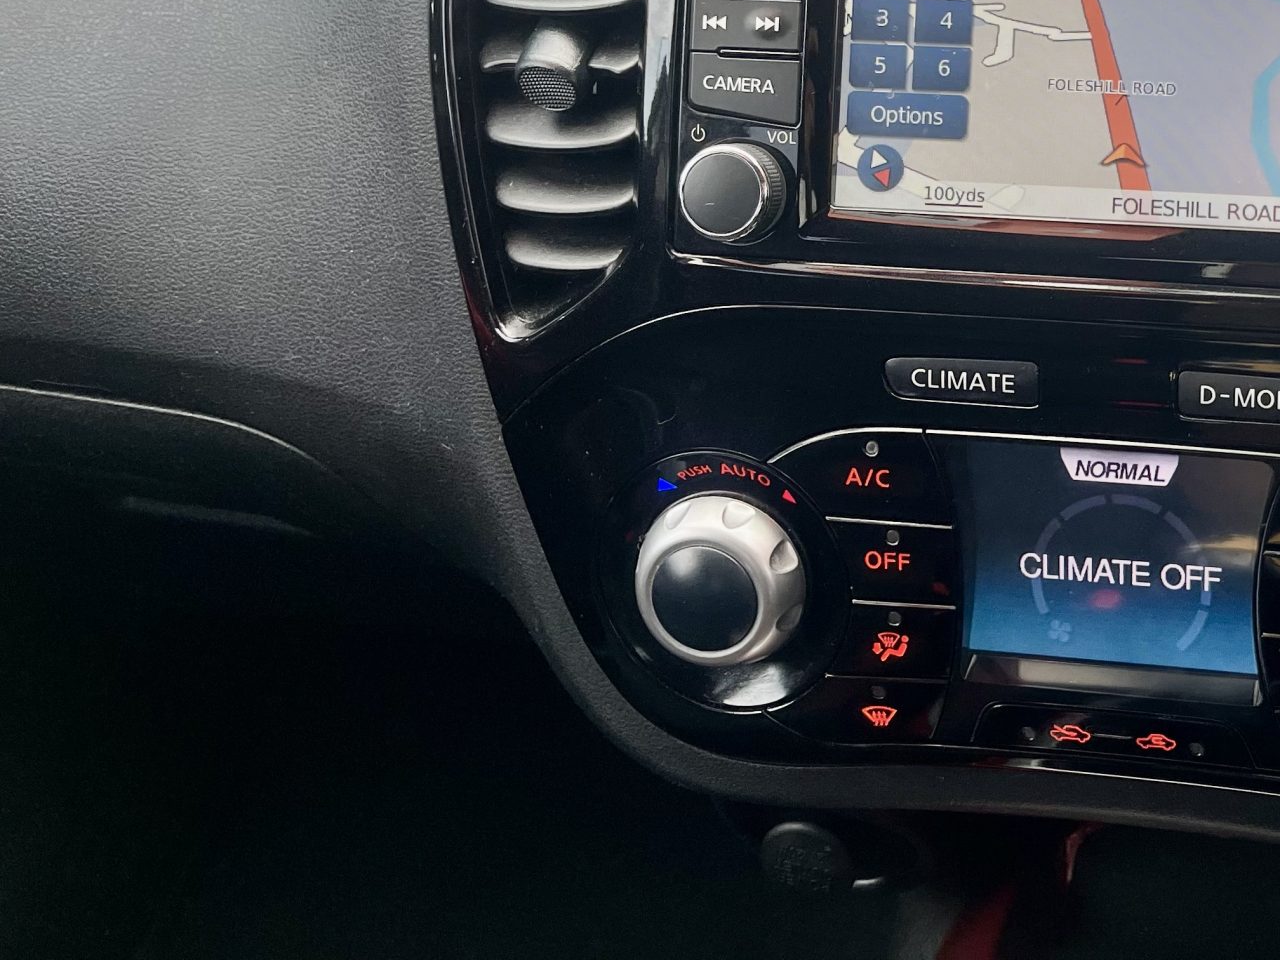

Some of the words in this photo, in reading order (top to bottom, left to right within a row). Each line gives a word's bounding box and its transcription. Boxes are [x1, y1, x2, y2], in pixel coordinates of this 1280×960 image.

[876, 10, 889, 27] 3
[940, 13, 953, 29] 4
[874, 58, 886, 75] 5
[938, 60, 951, 77] 6
[702, 75, 775, 95] CAMERA
[1047, 78, 1126, 94] FOLESHILL
[1132, 81, 1177, 96] ROAD
[870, 106, 943, 128] Options
[767, 131, 797, 145] VOL
[924, 185, 986, 204] 100yds
[1111, 197, 1219, 221] FOLESHILL
[911, 368, 1015, 394] CLIMATE
[677, 464, 713, 481] PUSH
[719, 463, 771, 487] AUTO
[845, 469, 890, 489] A/C
[1075, 459, 1165, 483] NORMAL
[864, 550, 911, 571] OFF
[1019, 553, 1150, 588] CLIMATE
[1160, 563, 1223, 592] OFF
